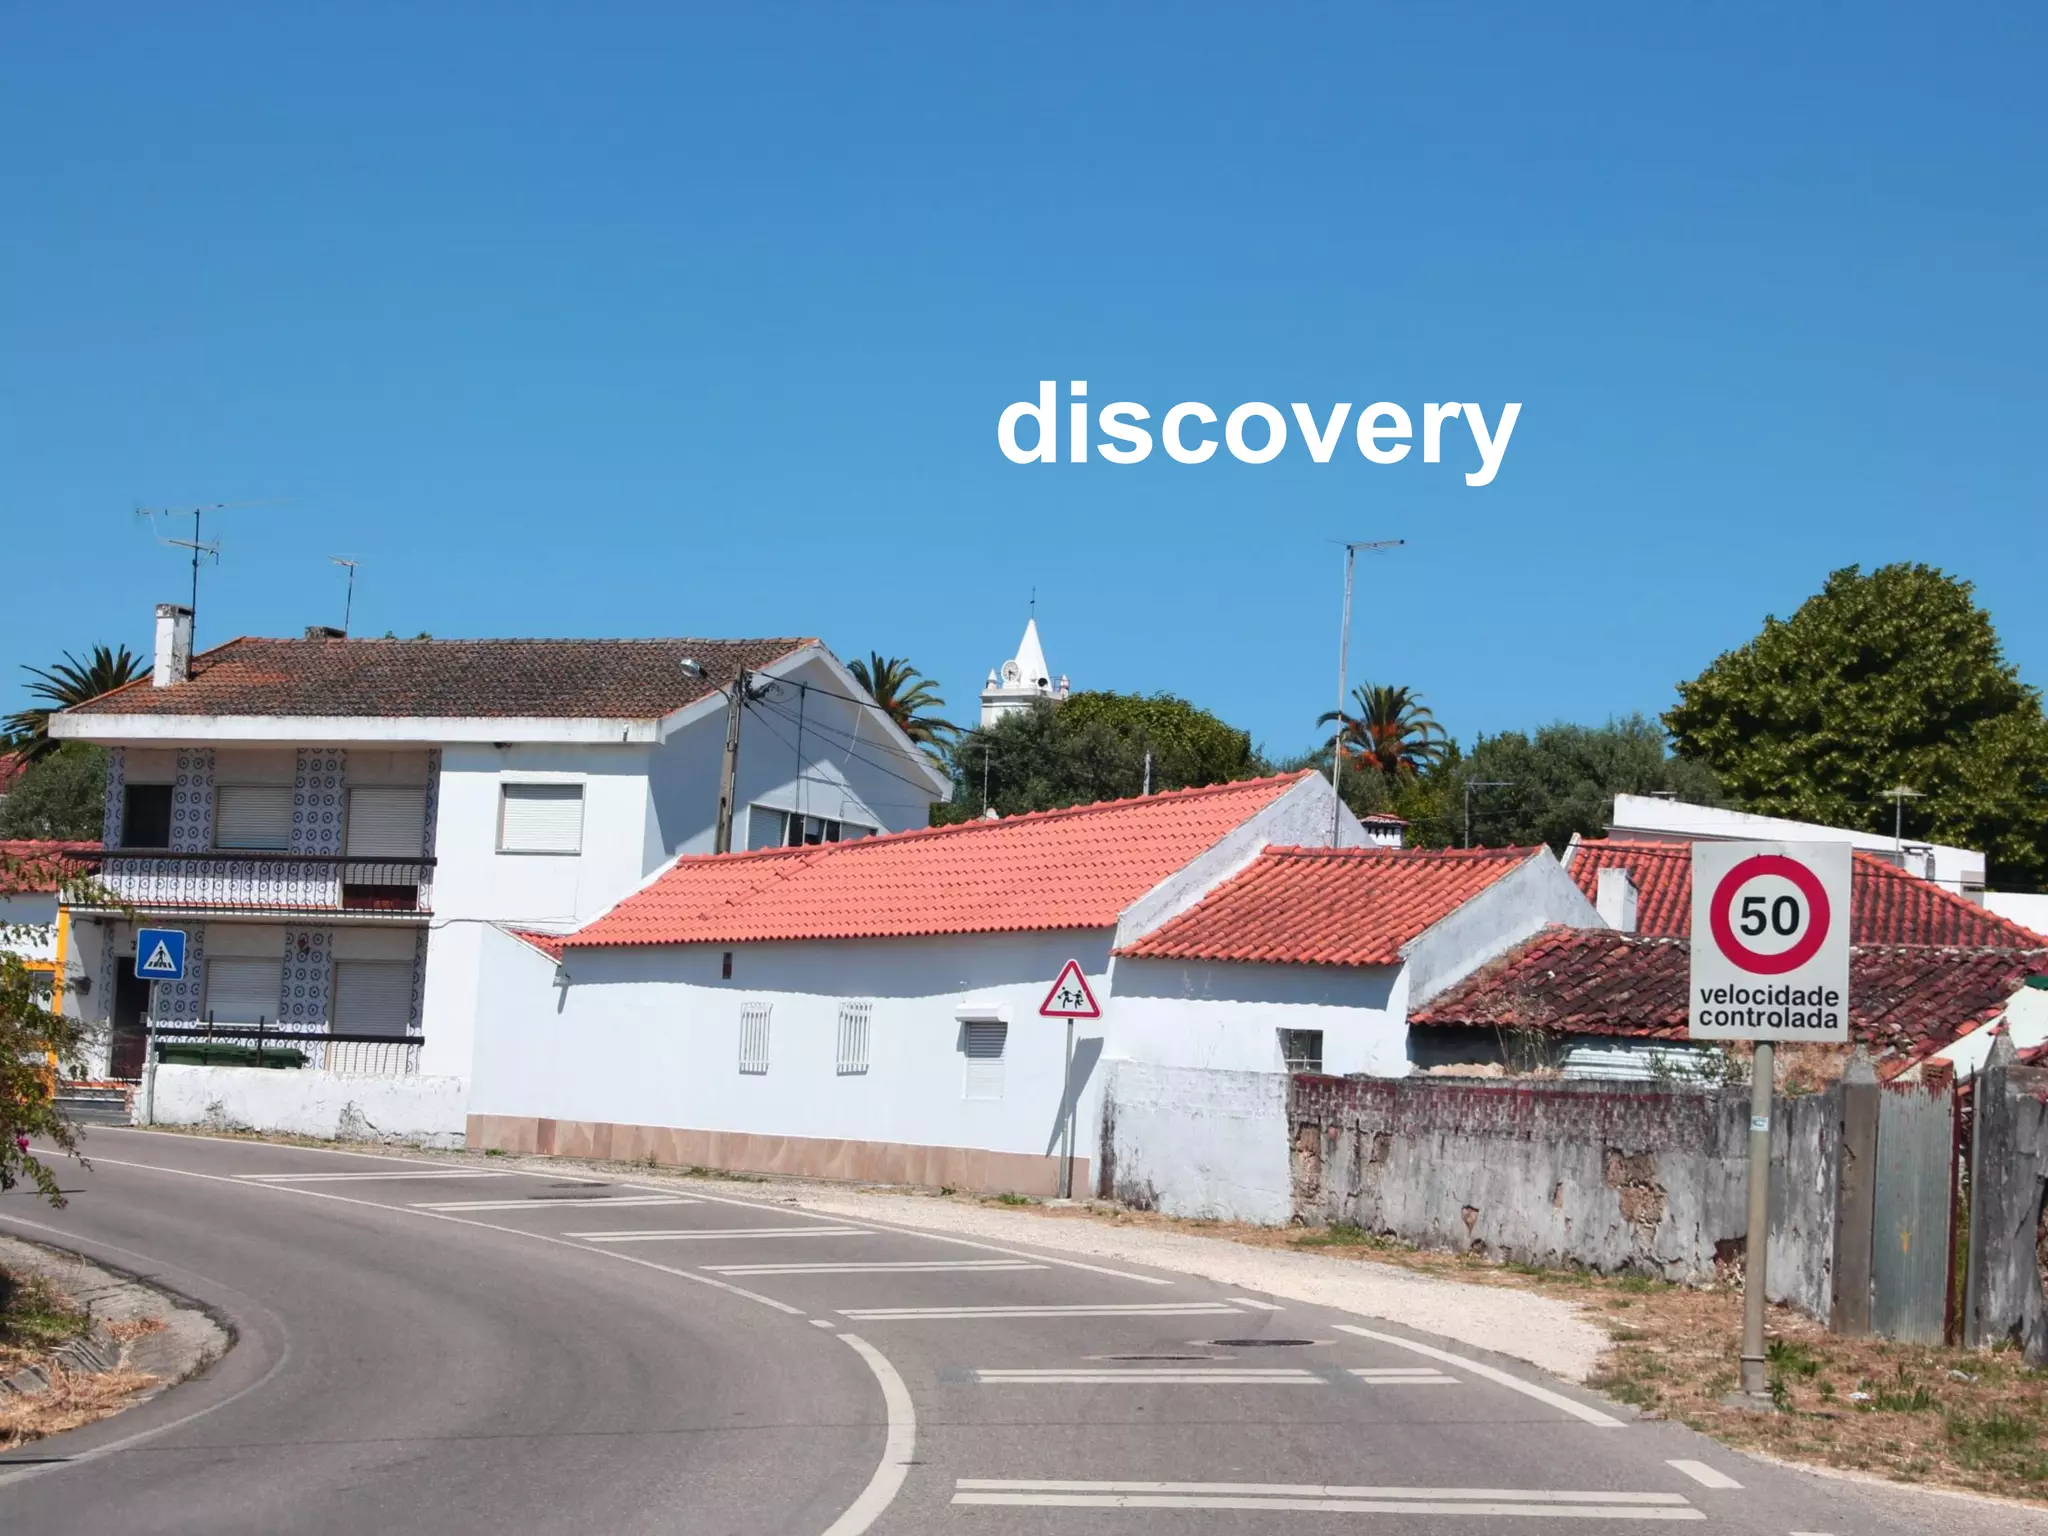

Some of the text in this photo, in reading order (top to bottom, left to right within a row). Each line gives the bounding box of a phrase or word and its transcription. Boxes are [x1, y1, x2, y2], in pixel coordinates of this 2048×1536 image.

[1740, 895, 1800, 936] 50
[1700, 984, 1839, 1007] velocidade
[1699, 1007, 1838, 1028] controlada
